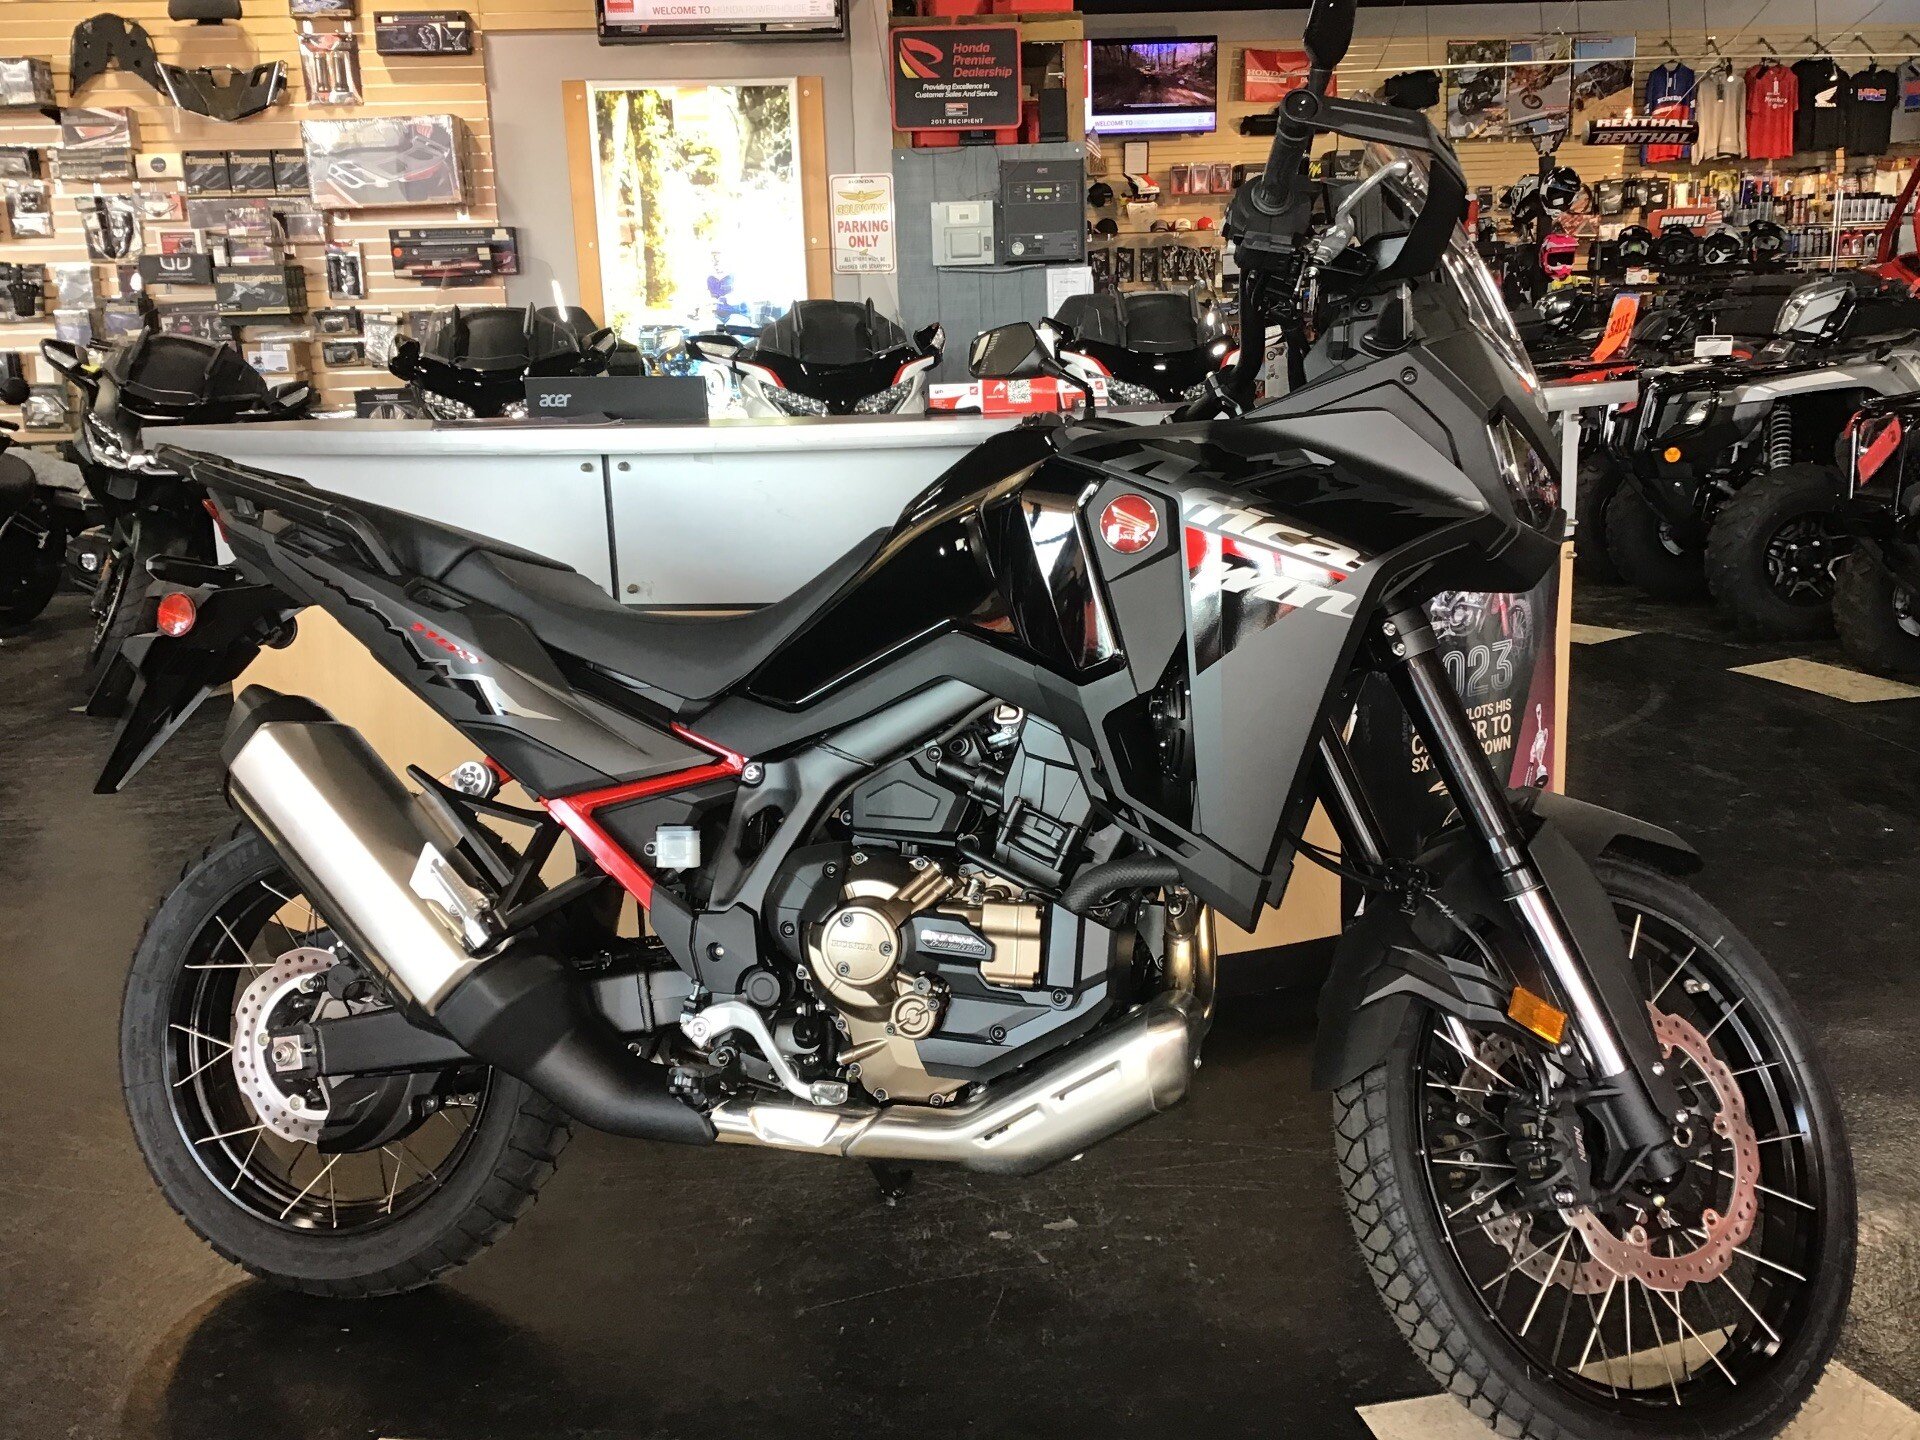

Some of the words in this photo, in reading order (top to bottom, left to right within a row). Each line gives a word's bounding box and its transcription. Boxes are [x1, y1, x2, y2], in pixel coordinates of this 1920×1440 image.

[653, 6, 697, 15] WELCOME
[699, 5, 711, 14] TO
[952, 42, 990, 54] Honda
[952, 54, 997, 65] Premier
[953, 66, 1013, 78] Dealership
[922, 83, 951, 91] Providing
[1596, 118, 1694, 128] RENTHAL
[1594, 132, 1692, 144] RENTHAL
[837, 219, 889, 233] PARKING
[848, 234, 879, 248] ONLY
[1608, 312, 1631, 338] SALE
[539, 393, 572, 407] acer
[1442, 639, 1514, 698] 023
[1466, 701, 1494, 720] LOTS
[1496, 698, 1512, 713] HIS
[1491, 714, 1512, 736] TO
[1411, 755, 1430, 774] SX
[1481, 735, 1512, 756] OWN
[831, 940, 876, 951] HONDA
